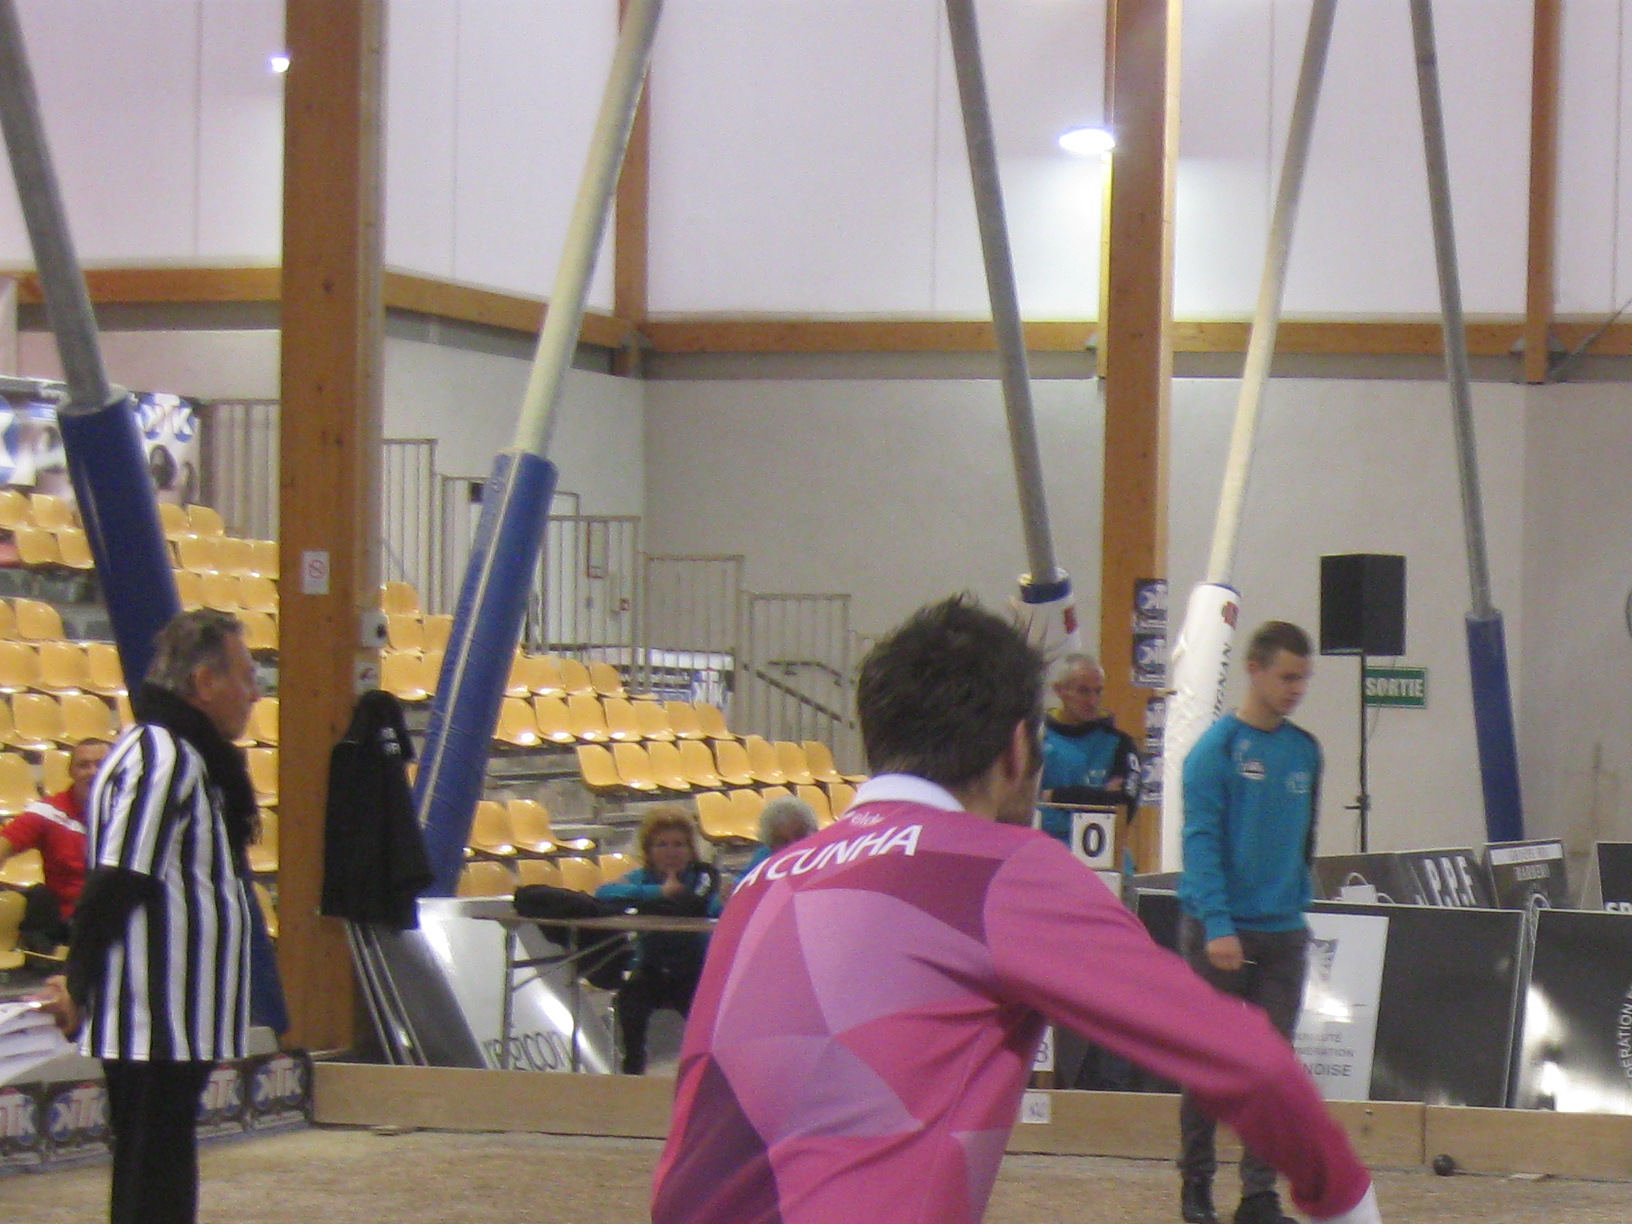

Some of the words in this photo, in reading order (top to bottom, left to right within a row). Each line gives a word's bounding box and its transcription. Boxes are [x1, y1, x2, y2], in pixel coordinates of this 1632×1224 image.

[1365, 677, 1424, 698] SORTIE
[765, 824, 924, 881] CUNHA
[1081, 822, 1106, 858] 0
